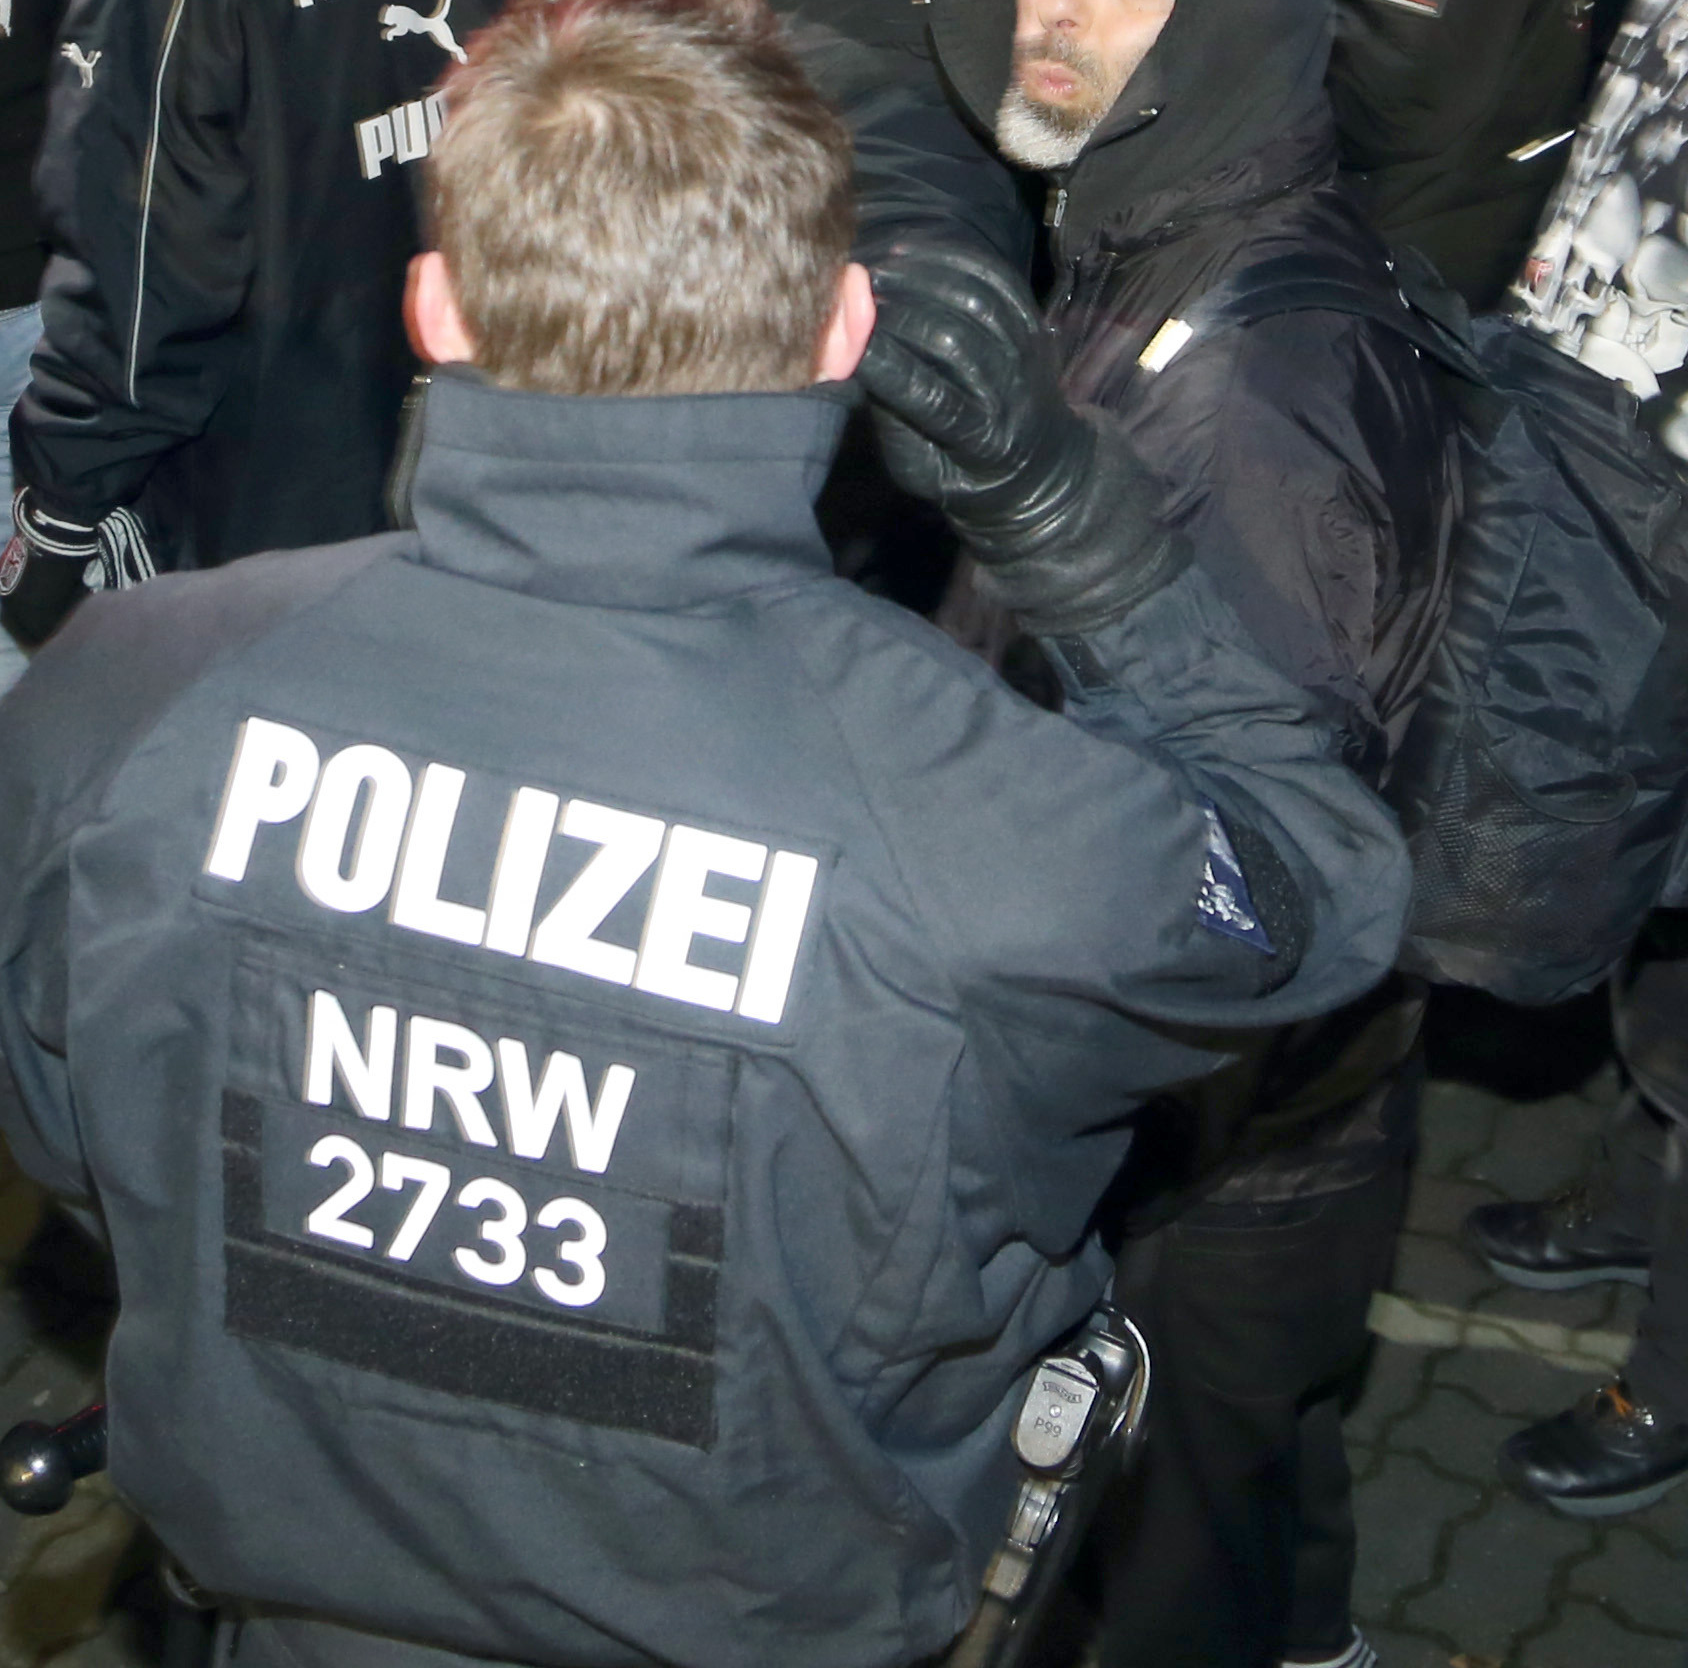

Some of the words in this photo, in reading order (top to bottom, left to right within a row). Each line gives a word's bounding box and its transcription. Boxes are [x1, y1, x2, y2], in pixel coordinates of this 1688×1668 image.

[204, 716, 819, 1025] POLIZEI
[302, 988, 637, 1174] NRW
[304, 1134, 608, 1308] 2733
